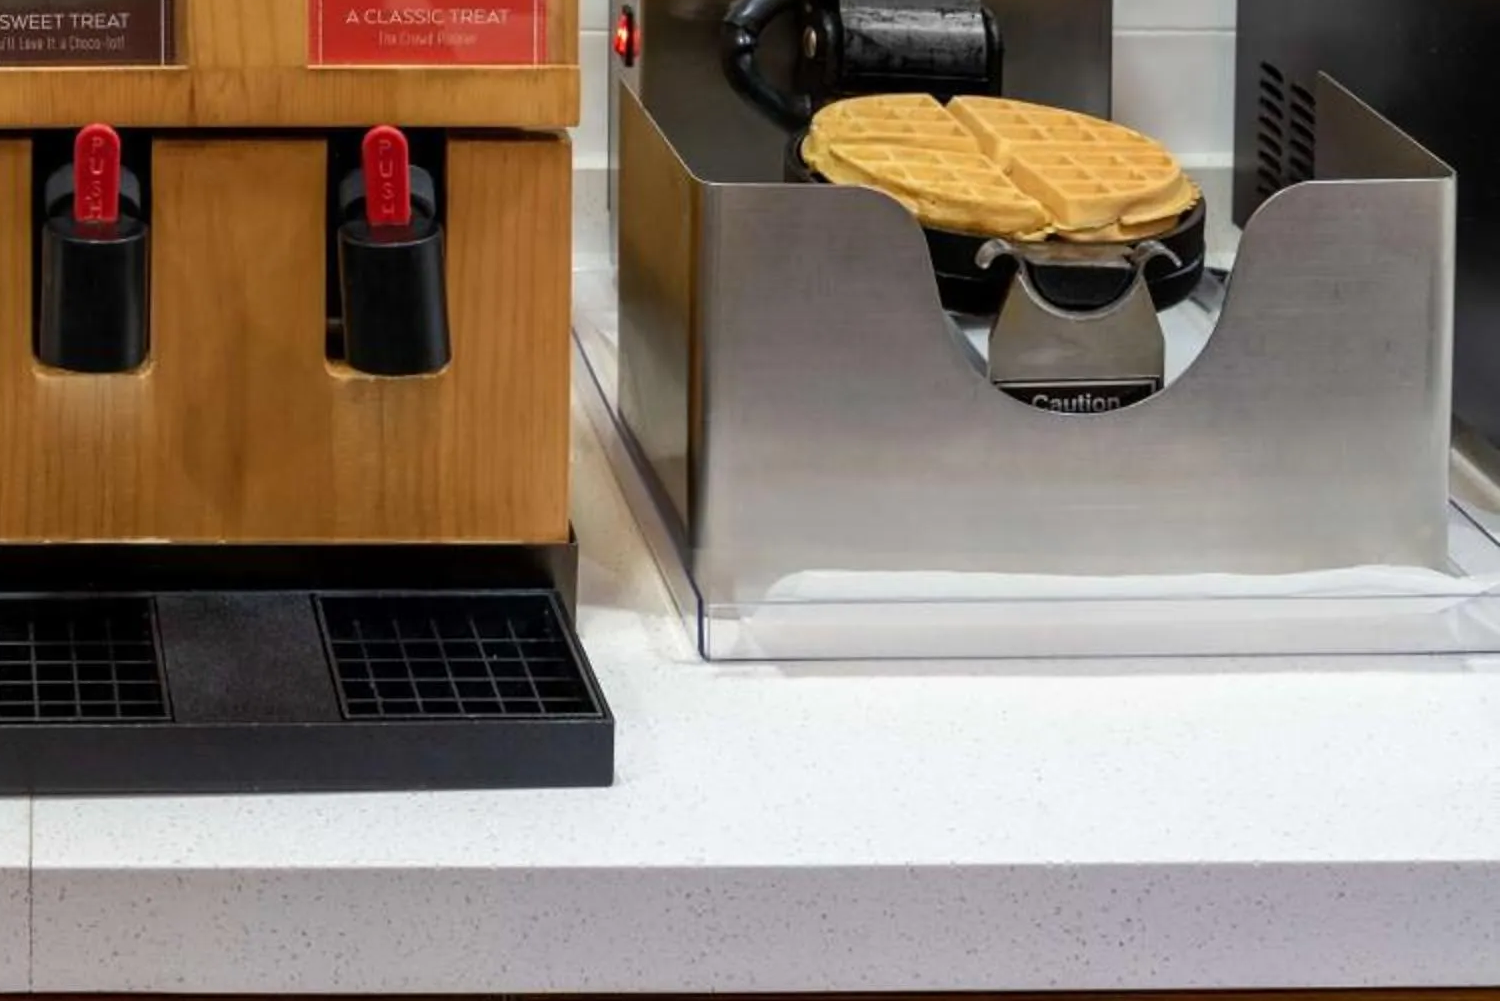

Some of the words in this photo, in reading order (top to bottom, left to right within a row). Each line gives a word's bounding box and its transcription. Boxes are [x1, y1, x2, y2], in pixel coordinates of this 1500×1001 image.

[0, 14, 64, 30] SWEET
[68, 13, 131, 29] TREAT
[346, 9, 360, 25] A
[363, 8, 445, 25] CLASSIC
[448, 8, 511, 25] TREAT
[1032, 393, 1120, 412] Caution
